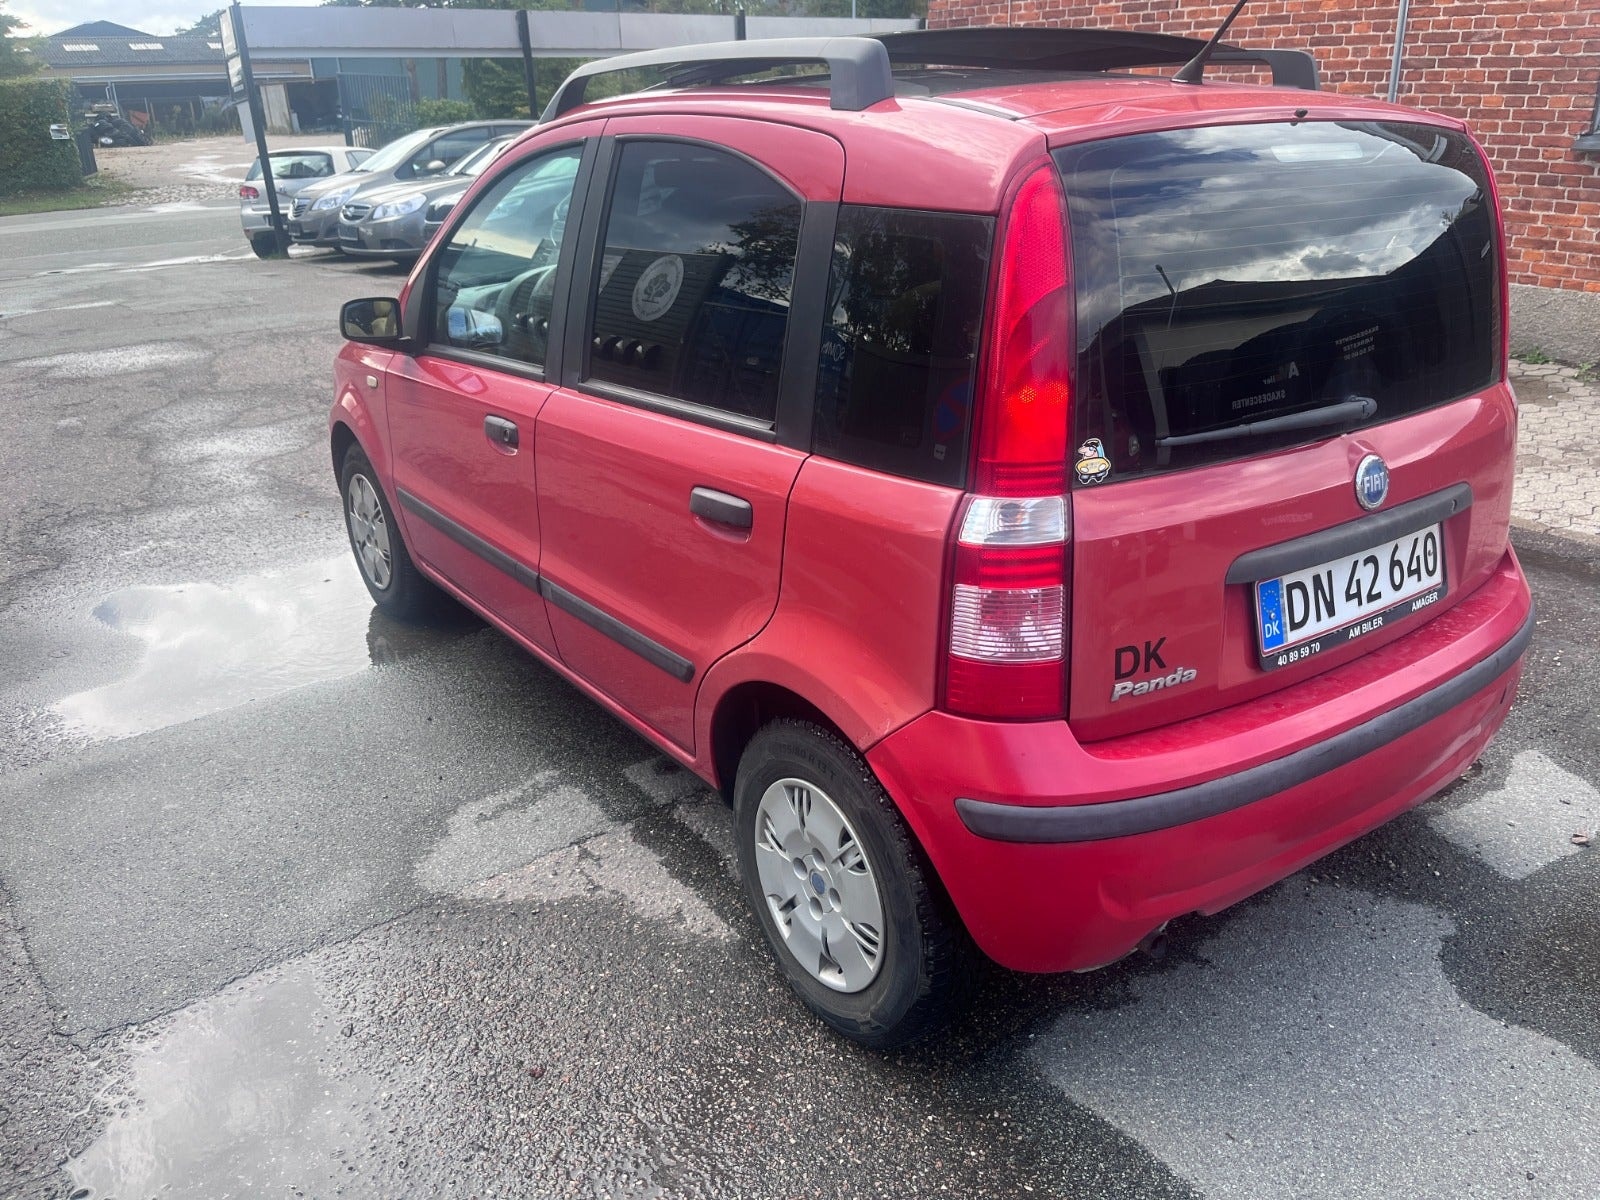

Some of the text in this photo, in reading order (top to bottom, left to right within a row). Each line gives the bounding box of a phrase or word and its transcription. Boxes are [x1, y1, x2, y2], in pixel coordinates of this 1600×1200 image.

[1363, 471, 1385, 494] FIAT
[1285, 531, 1438, 632] DN 42 640
[1264, 621, 1281, 639] DK
[1277, 591, 1439, 667] 40 89 59 70 AM BILER AMAGER
[1114, 637, 1167, 680] DK
[1110, 667, 1197, 702] Panda
